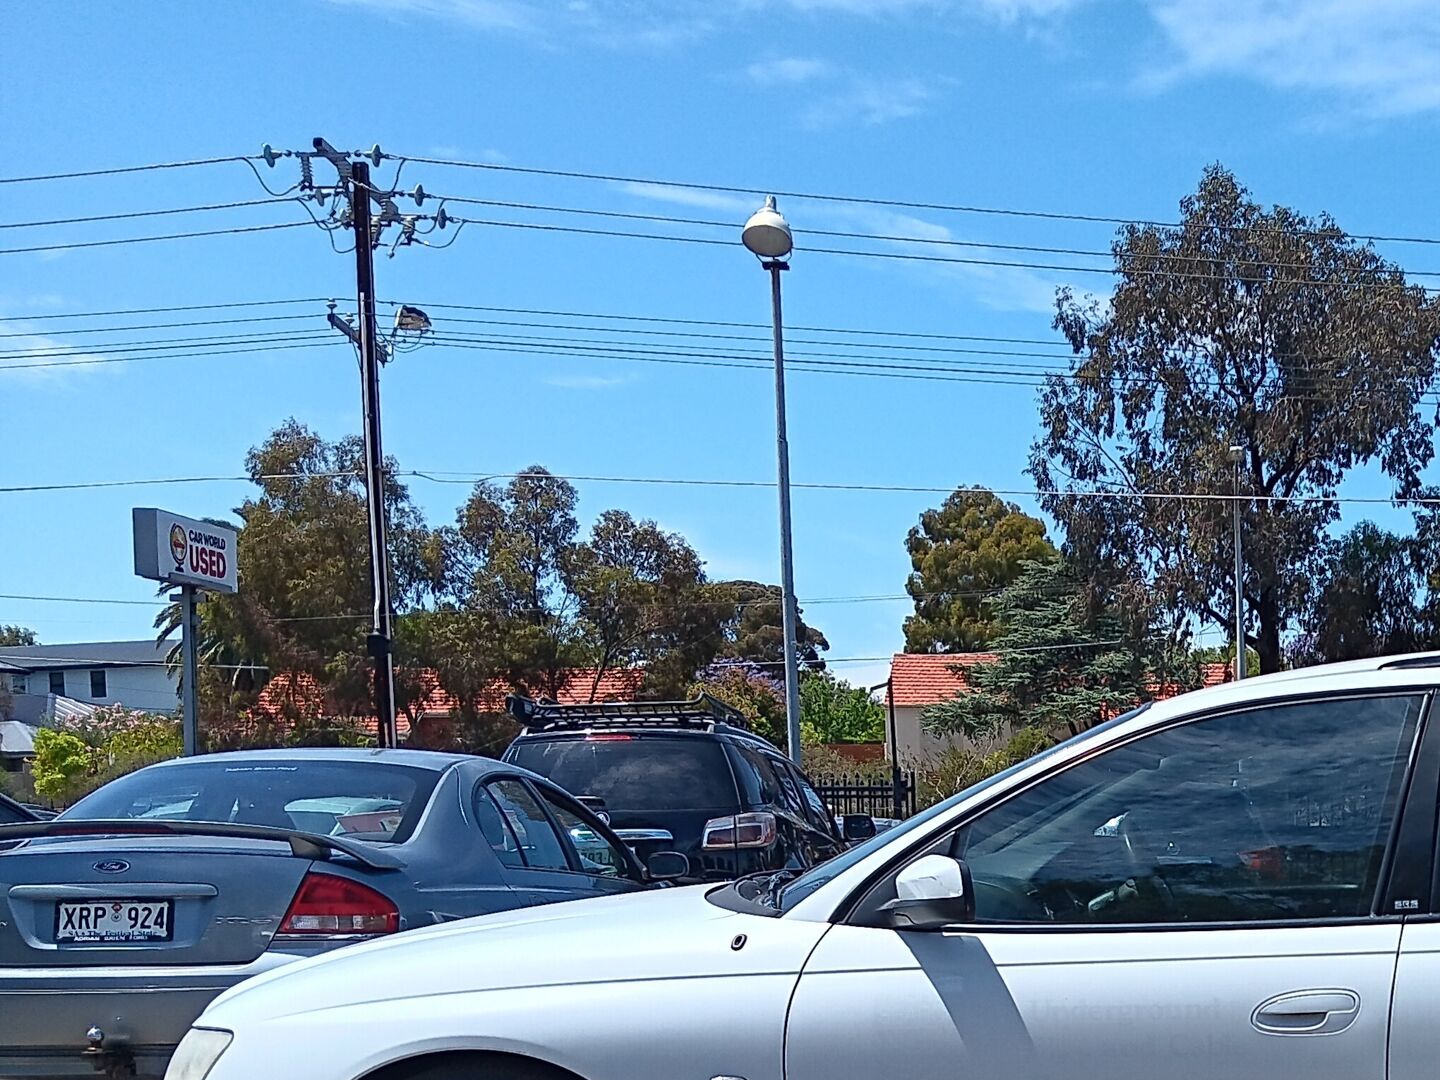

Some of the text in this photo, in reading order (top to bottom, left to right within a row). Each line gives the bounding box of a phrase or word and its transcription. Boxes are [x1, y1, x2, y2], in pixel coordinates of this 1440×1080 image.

[189, 544, 227, 579] USED
[62, 906, 165, 931] XRP 924
